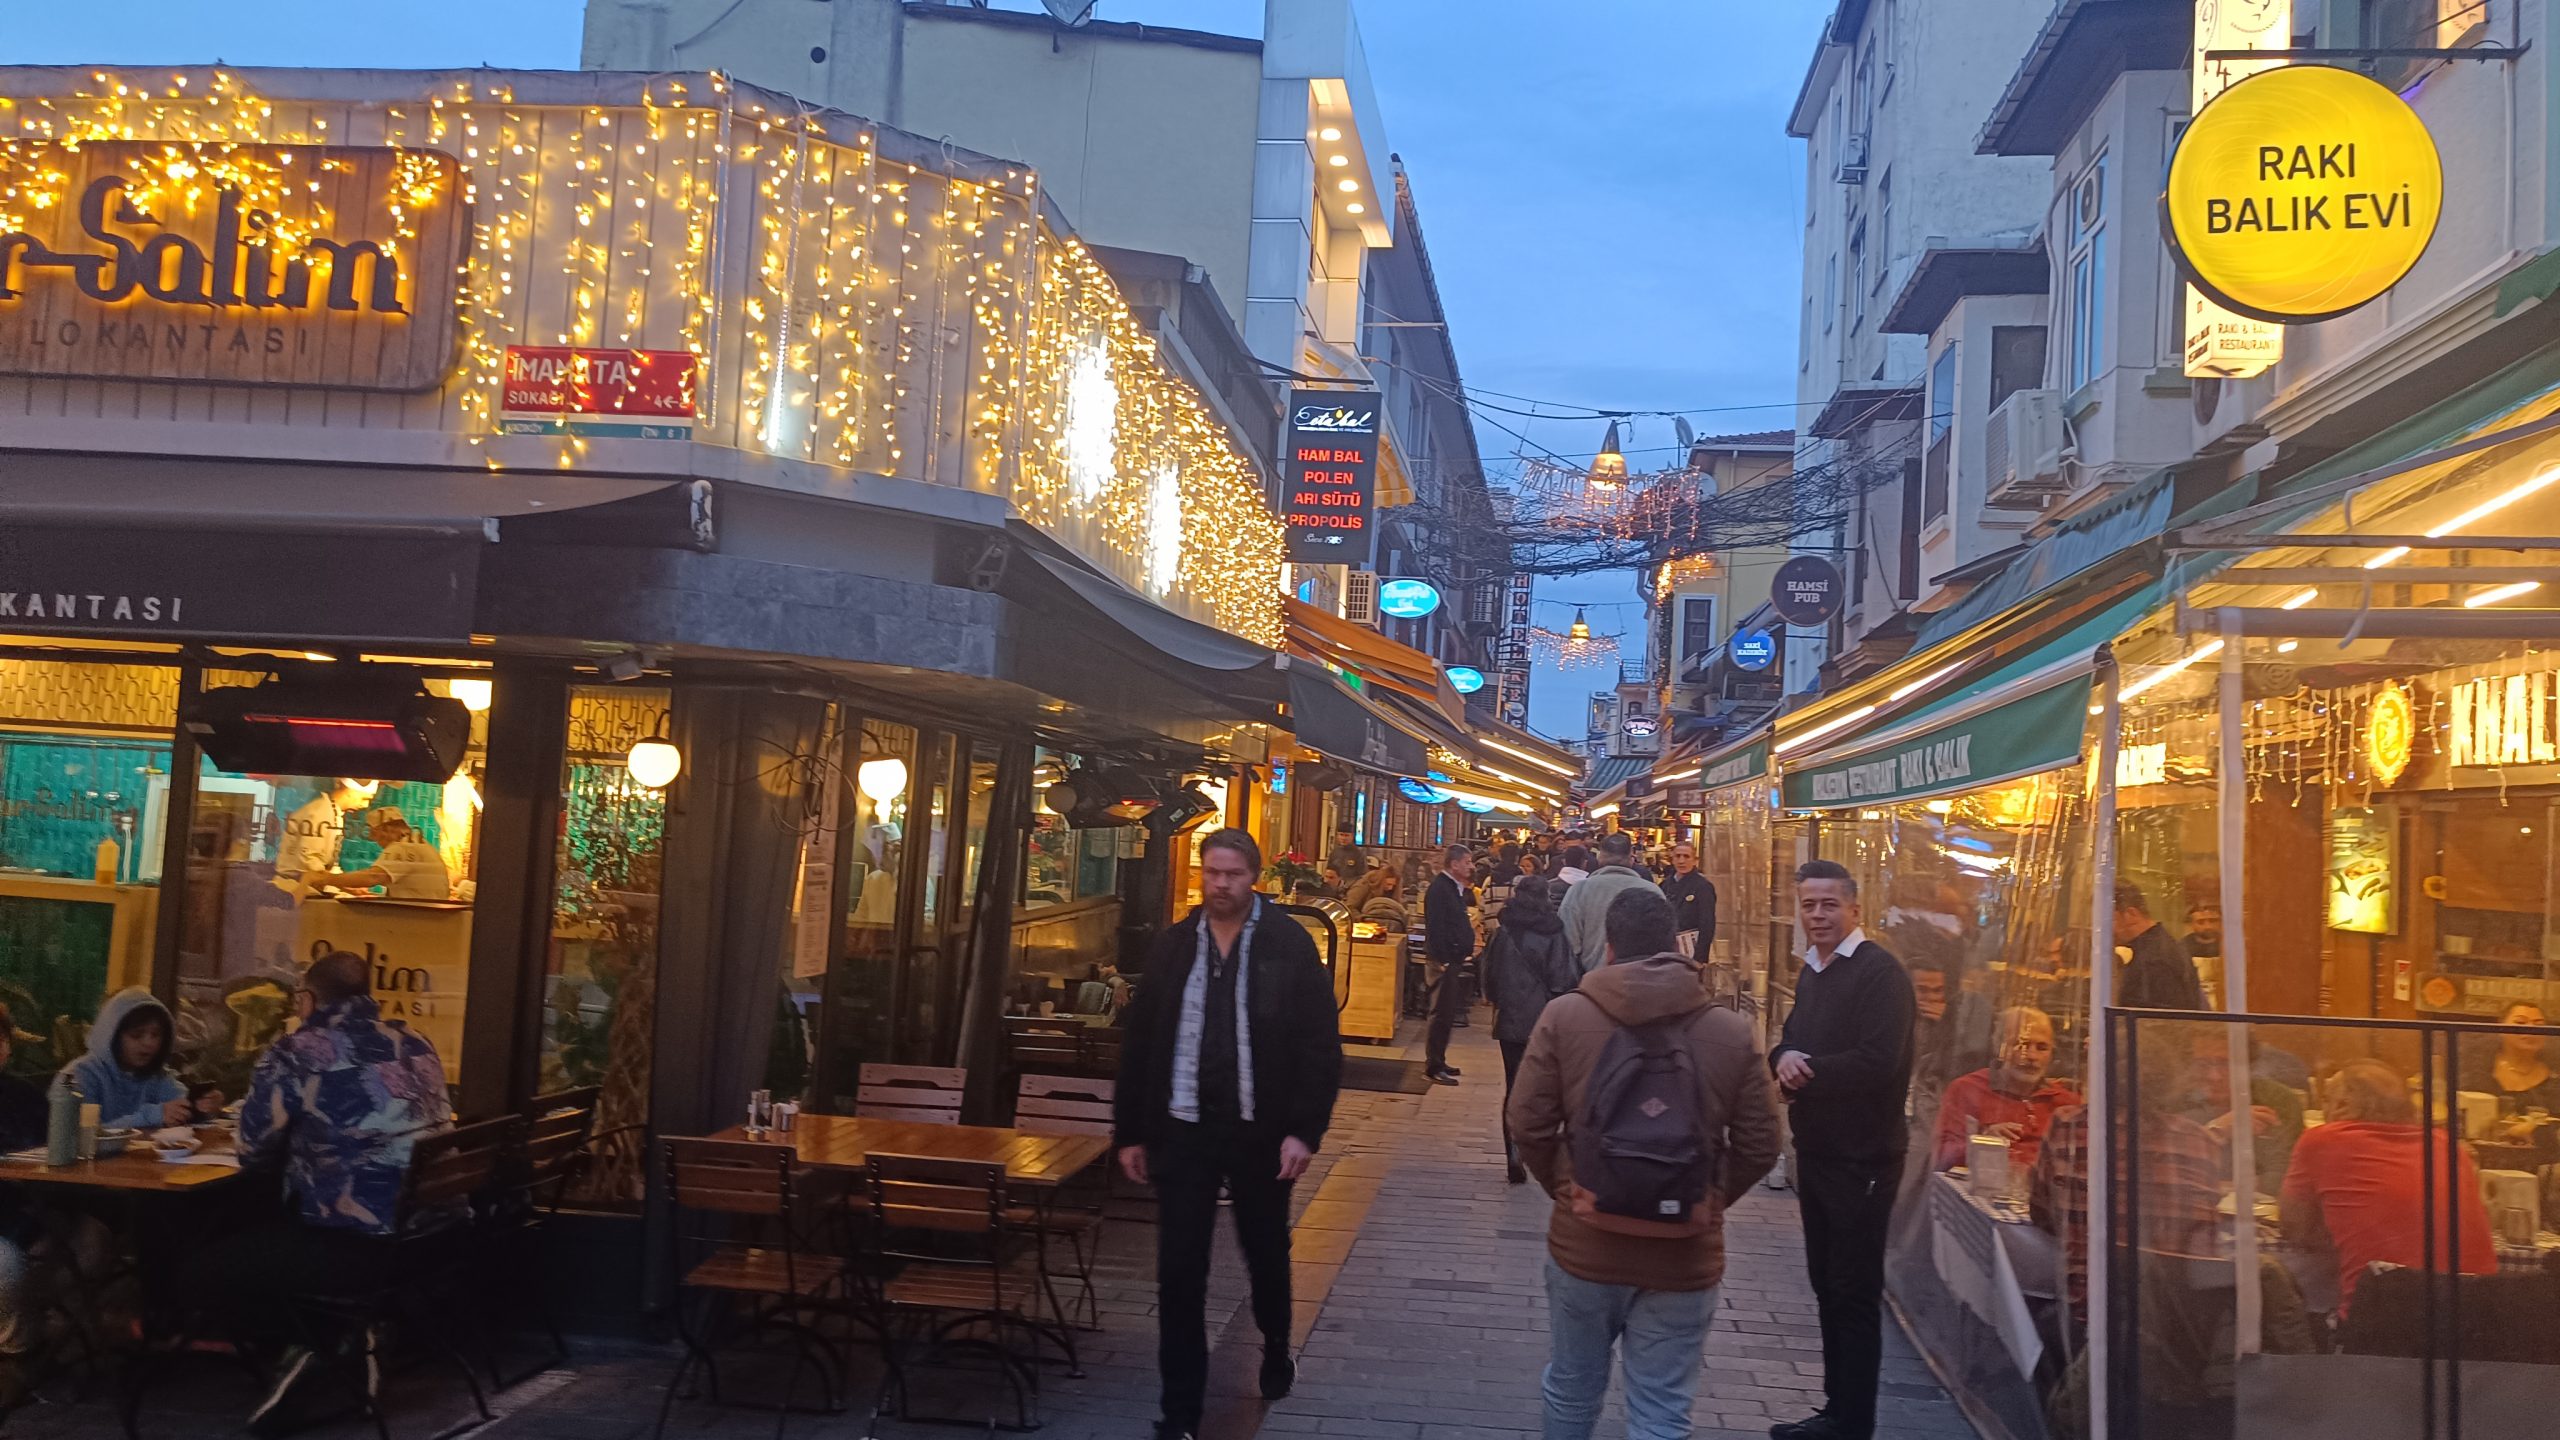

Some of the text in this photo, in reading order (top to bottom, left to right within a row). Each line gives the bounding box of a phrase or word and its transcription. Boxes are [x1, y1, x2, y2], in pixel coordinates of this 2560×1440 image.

[2259, 142, 2356, 182] RAKI
[2206, 182, 2411, 234] BALIK EVİ
[30, 317, 308, 356] LOKANTASI
[1297, 449, 1364, 464] HAM BAL
[1304, 471, 1354, 486] POLEN
[1293, 491, 1361, 508] ARI SÜTÜ
[1288, 513, 1363, 530] PROPOLİS
[1786, 579, 1829, 592] HAMSİ
[1793, 592, 1821, 603] PUB
